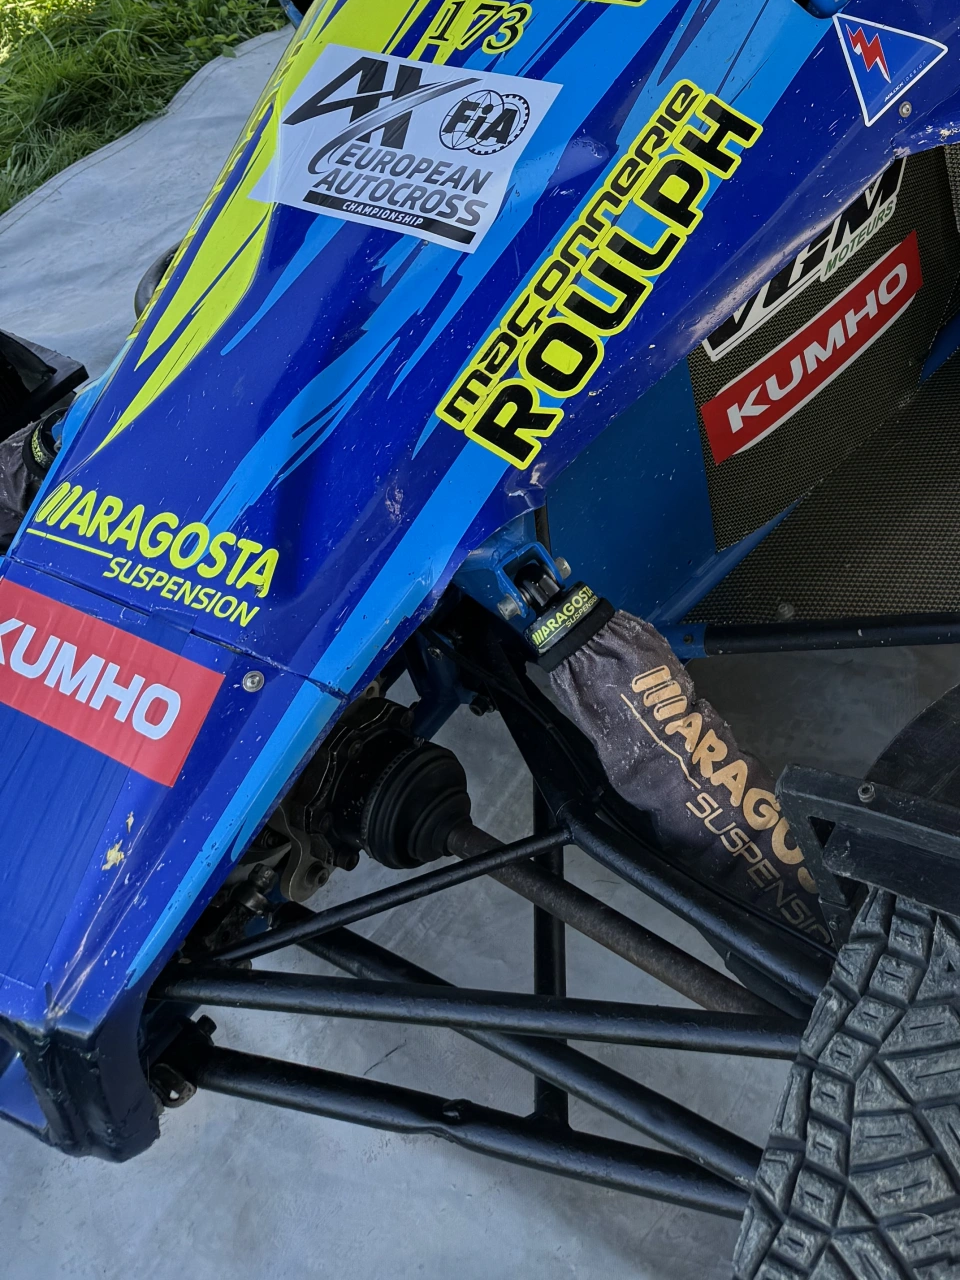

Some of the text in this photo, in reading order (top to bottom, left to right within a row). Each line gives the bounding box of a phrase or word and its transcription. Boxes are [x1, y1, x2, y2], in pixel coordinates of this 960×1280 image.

[312, 167, 489, 228] AUTOCROSS
[335, 142, 494, 196] EUROPEAN
[341, 200, 424, 228] CHAMPIONSHIP
[824, 199, 894, 277] MOTEURS
[471, 97, 758, 465] ROULPH
[726, 262, 908, 434] KUMHO
[103, 556, 261, 628] SUSPENSION
